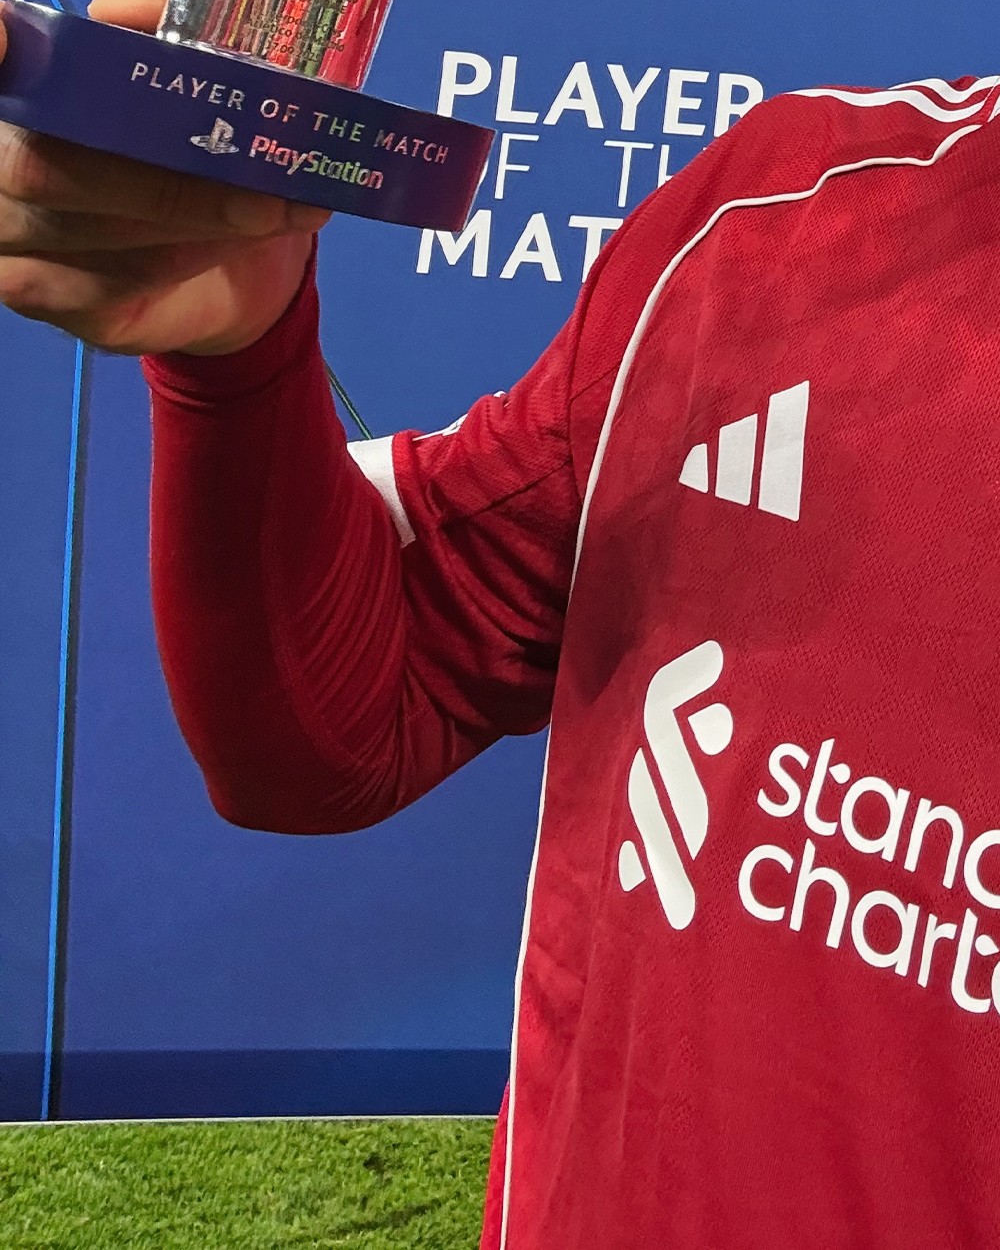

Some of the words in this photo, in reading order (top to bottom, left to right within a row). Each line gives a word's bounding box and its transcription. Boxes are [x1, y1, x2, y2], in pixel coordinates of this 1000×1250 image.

[131, 62, 246, 111] PLAYER
[260, 99, 299, 123] OF
[313, 112, 366, 142] THE
[374, 129, 449, 164] MATCH
[437, 51, 764, 137] PLAYER
[248, 134, 384, 189] PlayStation
[480, 133, 539, 200] F
